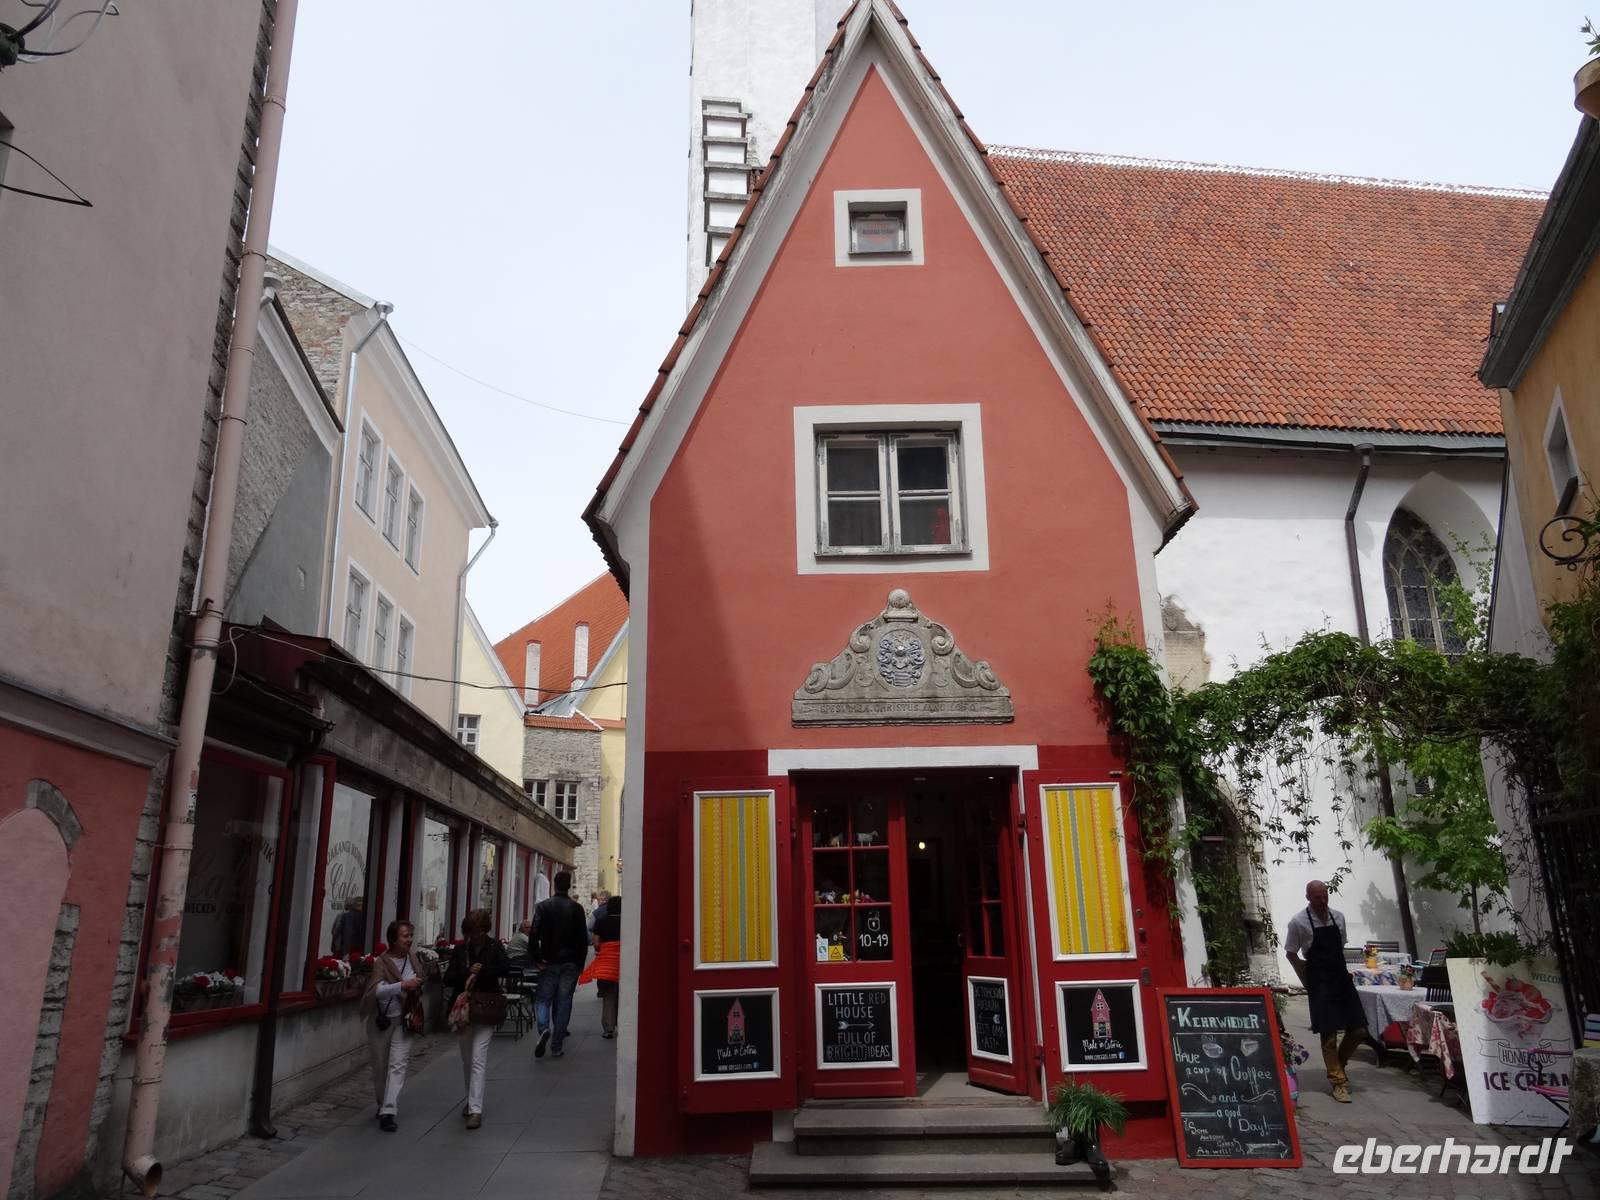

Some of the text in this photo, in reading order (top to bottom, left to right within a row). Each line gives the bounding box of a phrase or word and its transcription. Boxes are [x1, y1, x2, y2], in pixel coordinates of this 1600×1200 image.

[858, 933, 889, 947] 10-19
[828, 991, 888, 1006] LITTLE RED
[836, 1006, 874, 1019] HOUSE
[1177, 1007, 1259, 1029] KEHRWIEDER
[838, 1032, 877, 1045] FULL OF
[827, 1045, 890, 1060] BRIGHT IDEAS
[1194, 1066, 1210, 1084] cup
[1230, 1055, 1273, 1096] Coffee
[1483, 1071, 1511, 1091] ICE
[1218, 1091, 1240, 1103] and
[1216, 1104, 1242, 1129] a good
[1238, 1114, 1269, 1137] Day!
